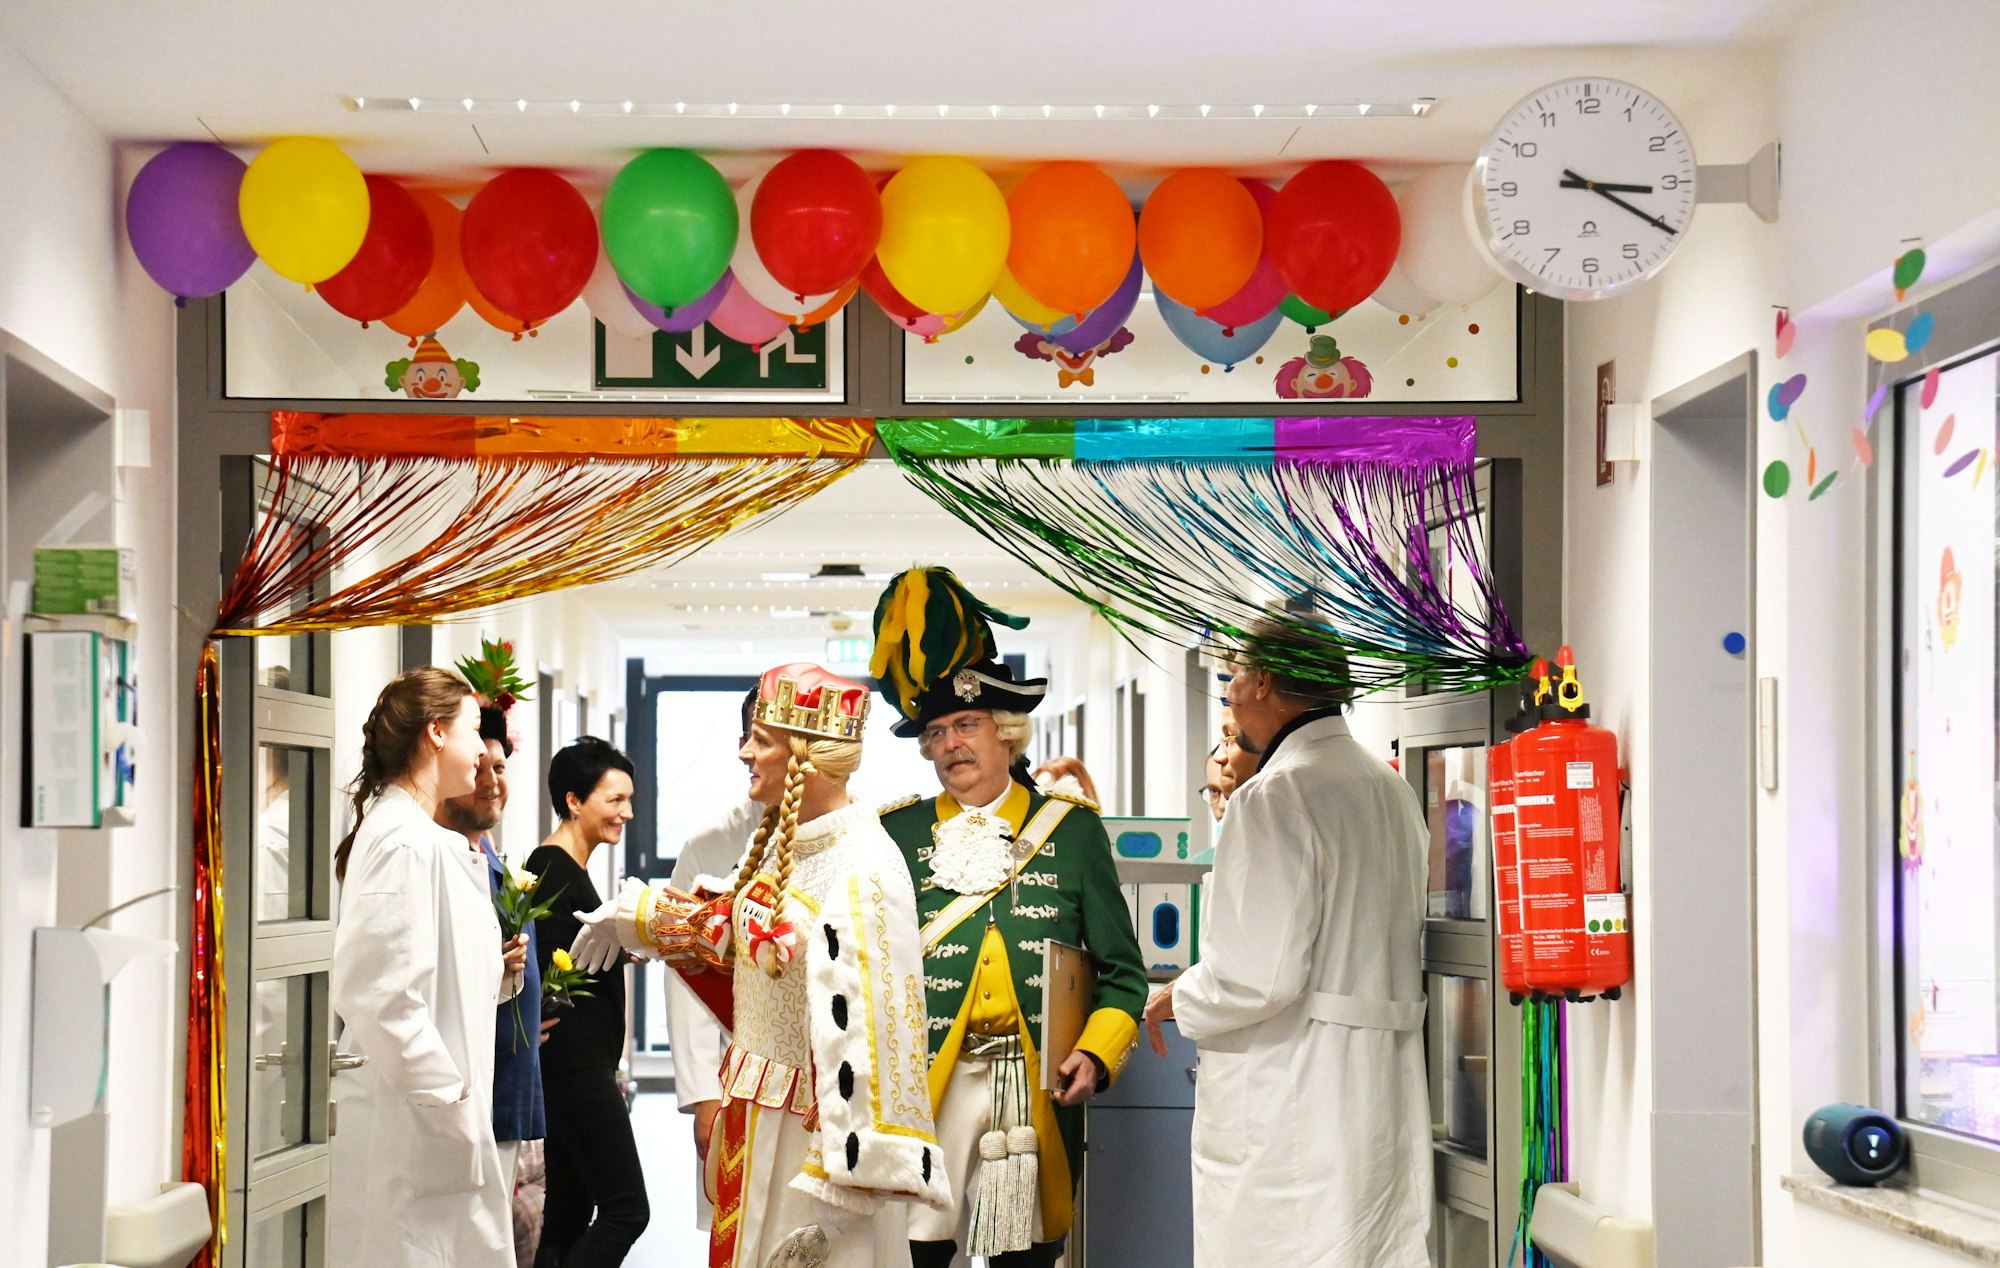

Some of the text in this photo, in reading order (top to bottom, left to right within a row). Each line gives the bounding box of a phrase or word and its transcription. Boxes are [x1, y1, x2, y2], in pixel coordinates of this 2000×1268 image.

[1575, 98, 1601, 114] 12
[1539, 112, 1556, 127] 11
[1624, 108, 1632, 123] 1
[1511, 142, 1538, 158] 10
[1649, 136, 1666, 152] 2
[1501, 182, 1517, 197] 9
[1661, 175, 1678, 190] 3
[1513, 220, 1530, 235] 8
[1544, 248, 1561, 264] 7
[1622, 244, 1639, 259] 5
[1582, 258, 1599, 273] 6
